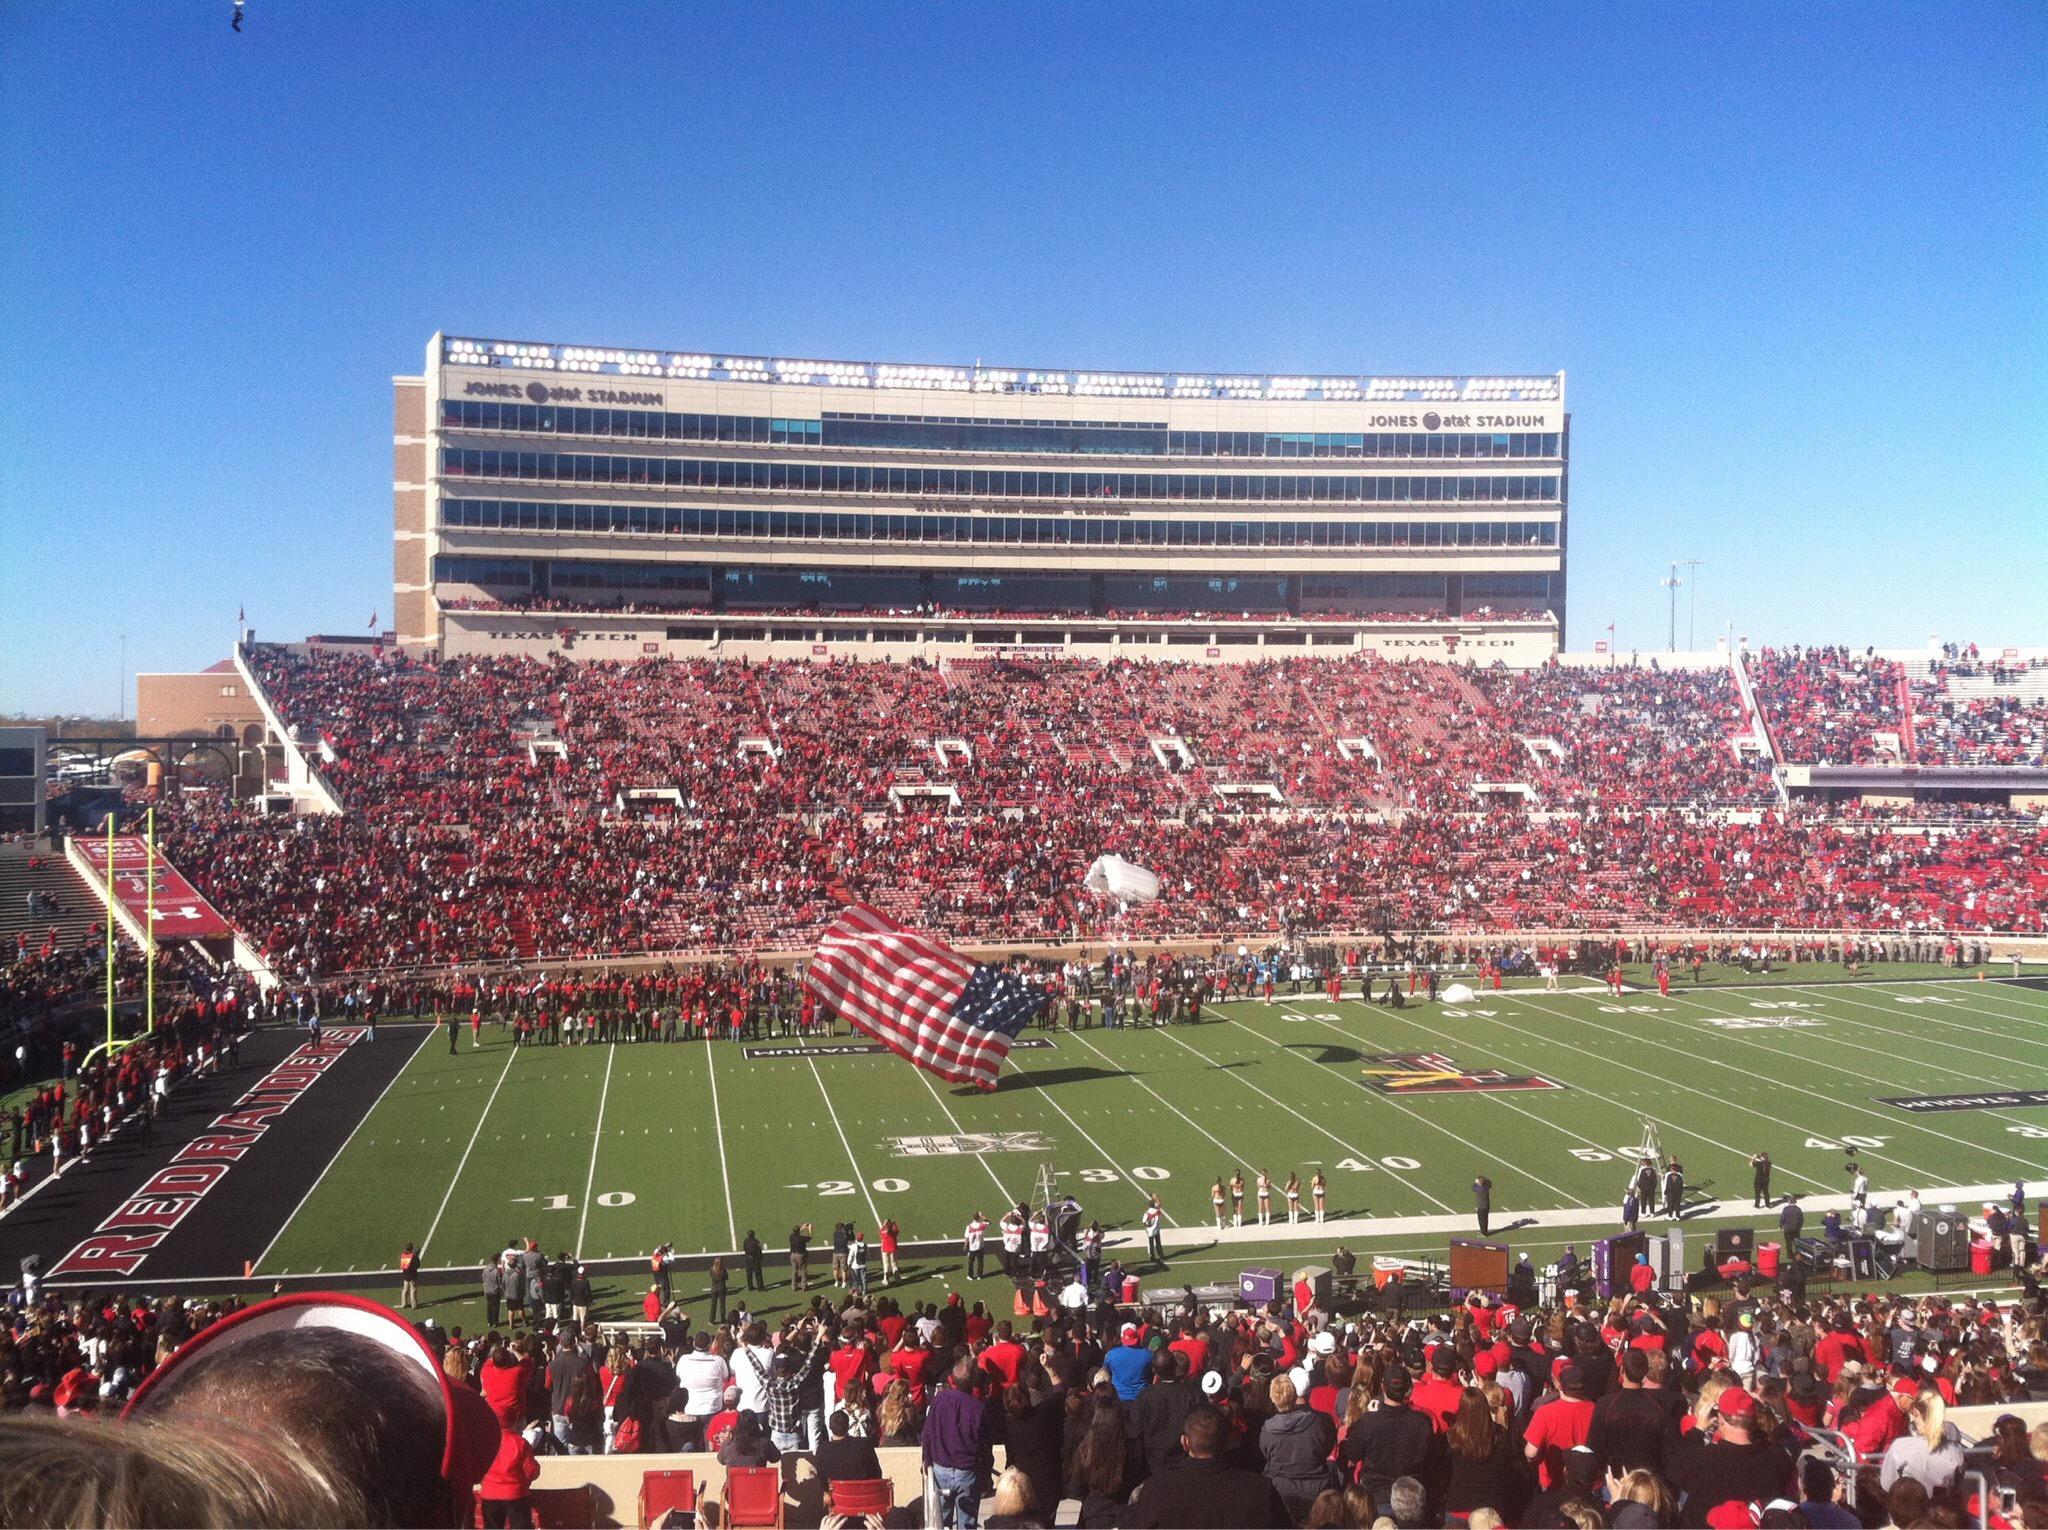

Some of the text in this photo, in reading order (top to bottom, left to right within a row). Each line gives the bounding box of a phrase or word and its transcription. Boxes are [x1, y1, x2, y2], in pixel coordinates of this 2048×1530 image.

[463, 381, 523, 398] JONES
[587, 389, 664, 406] STADIUM
[1368, 415, 1418, 427] JONES
[1477, 415, 1545, 427] STADIUM
[488, 631, 552, 641] TEXAS
[580, 633, 638, 641] TECH
[1382, 639, 1440, 647] TEXAS
